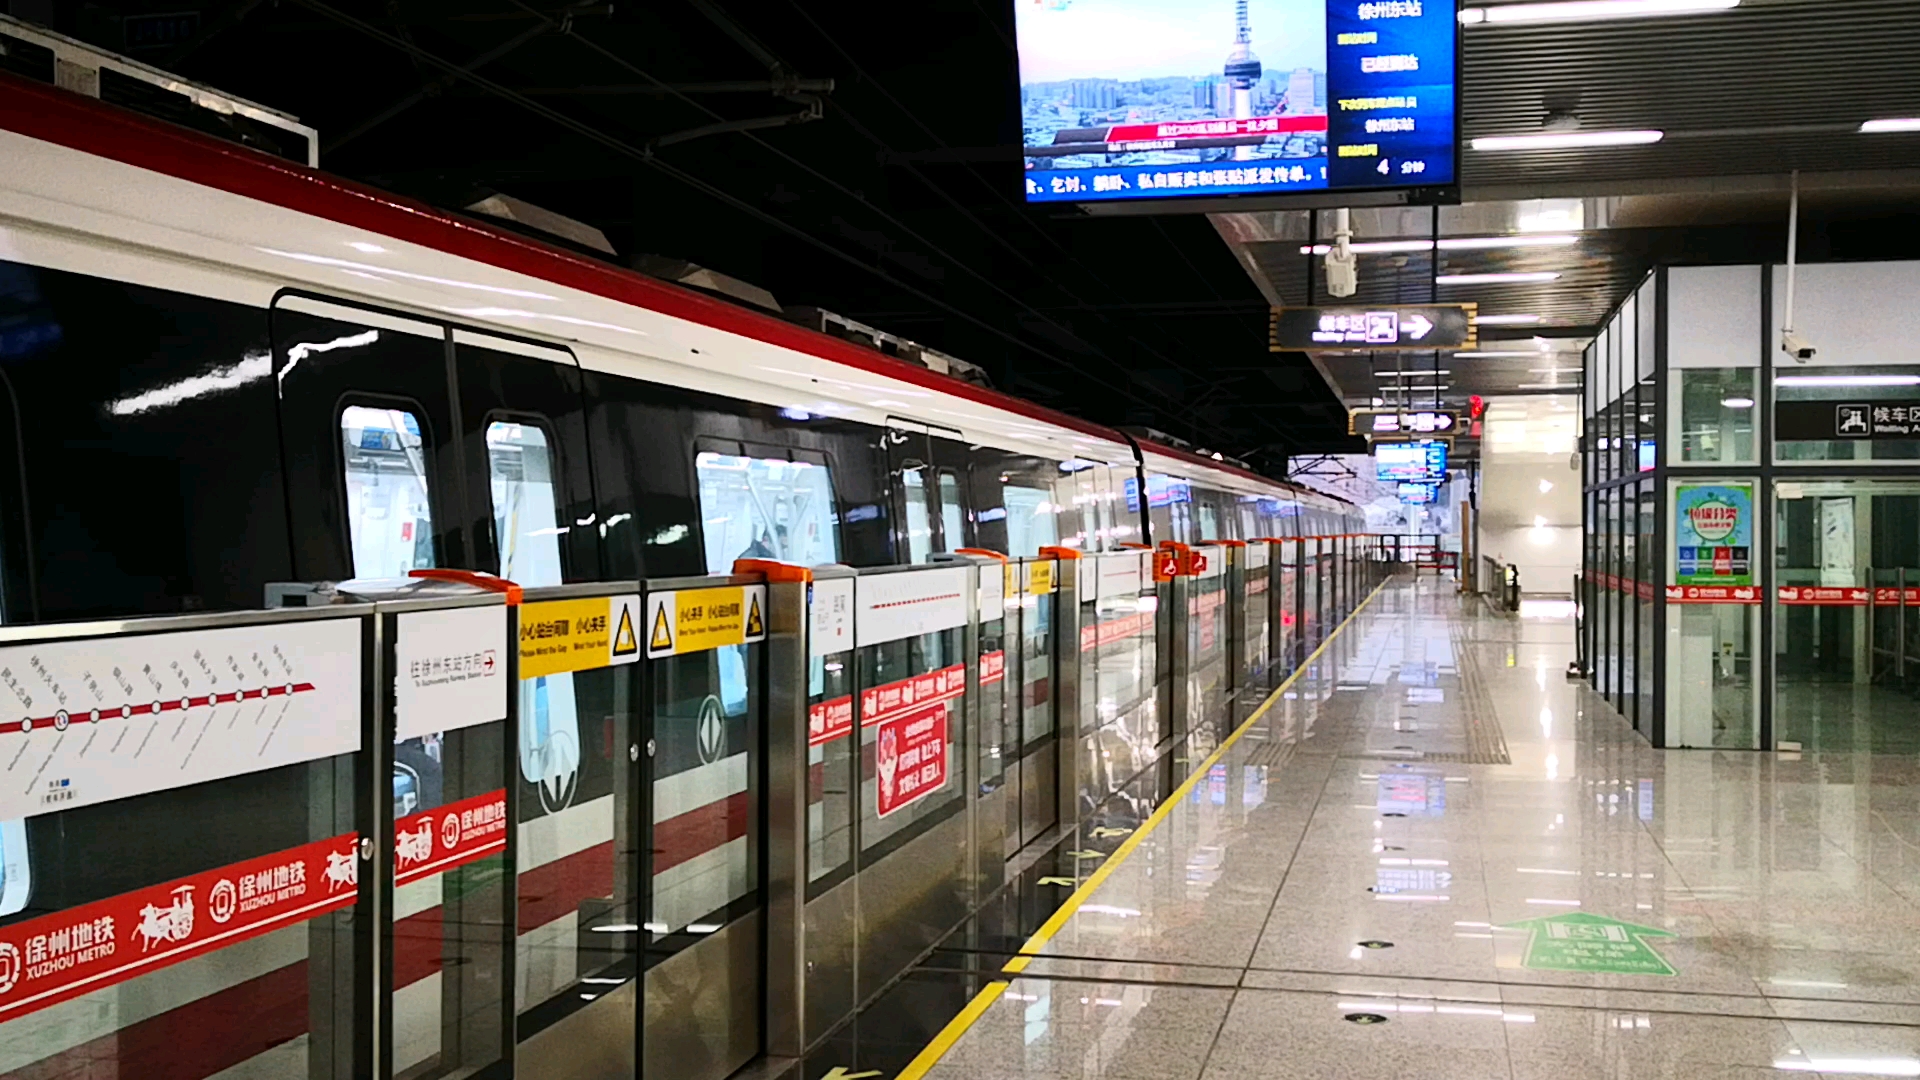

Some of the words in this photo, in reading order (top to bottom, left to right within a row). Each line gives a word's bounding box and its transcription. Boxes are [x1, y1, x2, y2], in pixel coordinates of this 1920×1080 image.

[1358, 0, 1422, 20] 徐州东站
[1377, 159, 1389, 175] 4
[1873, 406, 1920, 422] 候车区
[1874, 425, 1909, 434] Waiting
[576, 615, 606, 634] 小心夹手
[460, 800, 506, 830] 徐州地铁
[238, 860, 306, 900] 徐州地铁
[239, 888, 276, 914] XUZHOU
[277, 883, 306, 903] METRO
[25, 916, 116, 965] 徐州地铁
[25, 955, 75, 981] XUZHOU
[77, 942, 116, 963] METRO
